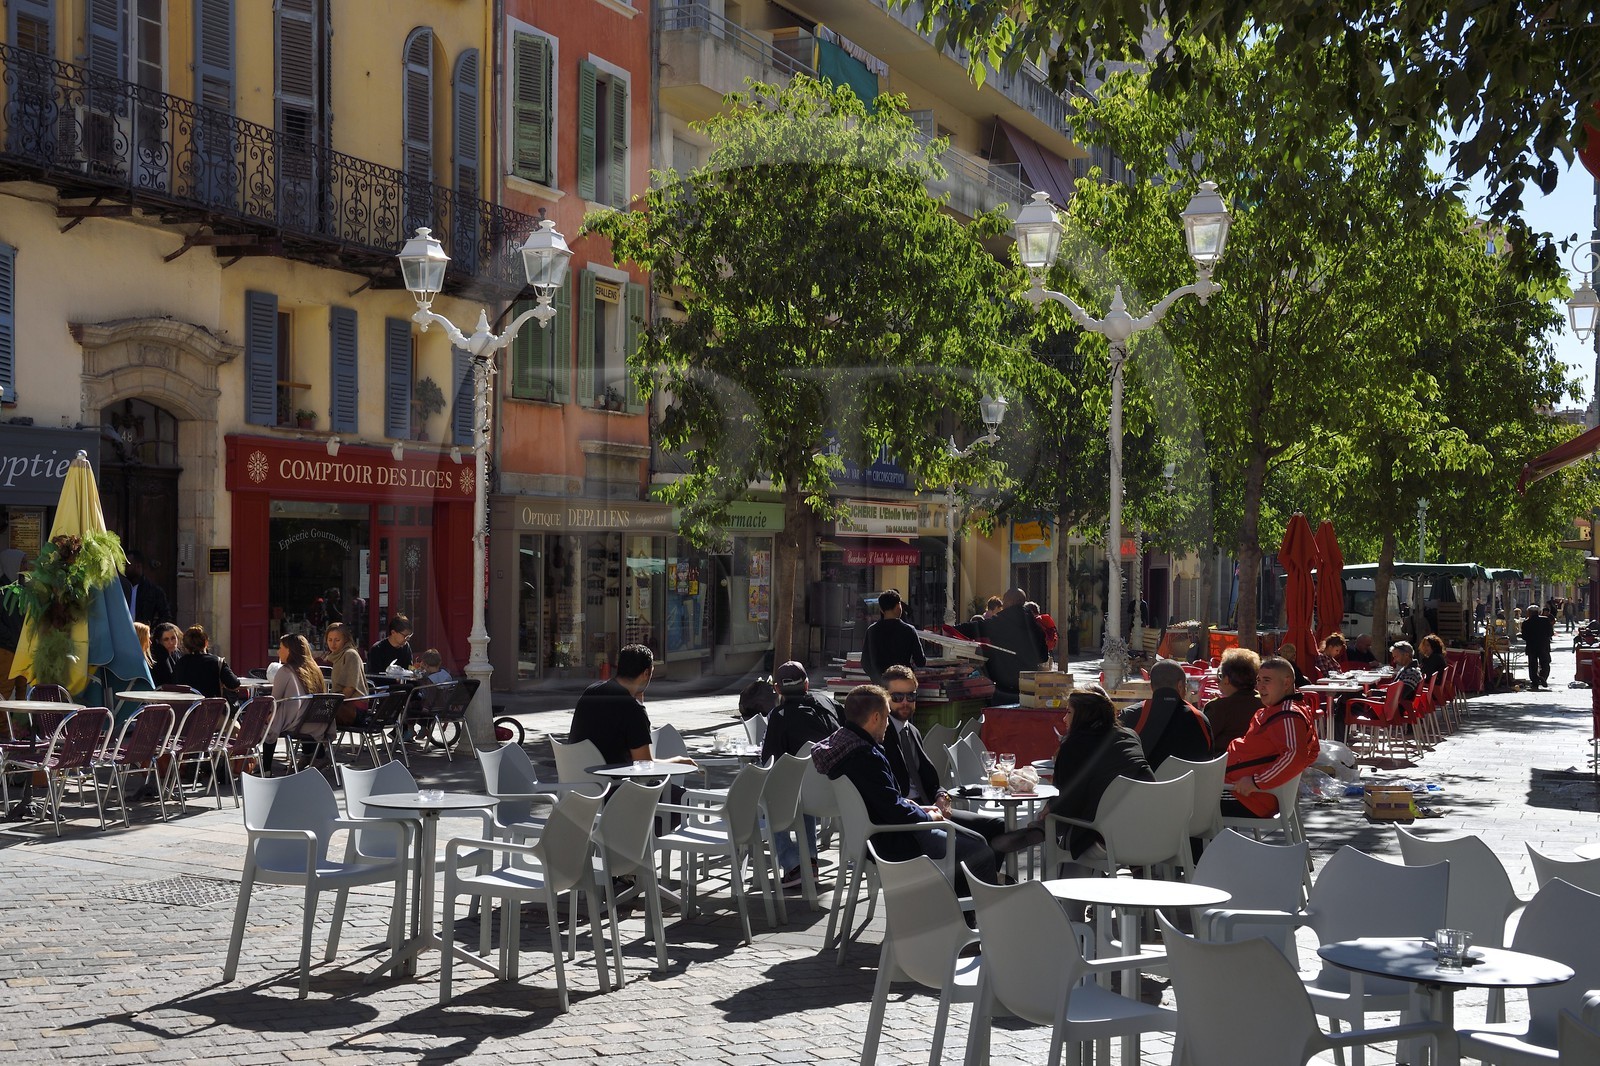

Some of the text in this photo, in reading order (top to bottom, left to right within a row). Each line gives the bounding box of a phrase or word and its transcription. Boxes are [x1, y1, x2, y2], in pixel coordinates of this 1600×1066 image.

[595, 286, 617, 300] EPALLENS
[121, 430, 133, 442] 48
[0, 450, 70, 487] ptie
[279, 459, 453, 489] COMPTOIR DES LICES
[872, 470, 905, 484] CIRCONSCRIPTION
[568, 508, 630, 528] DEPALLENS
[722, 511, 767, 528] armacie
[278, 527, 352, 552] Epicerie Gourmande
